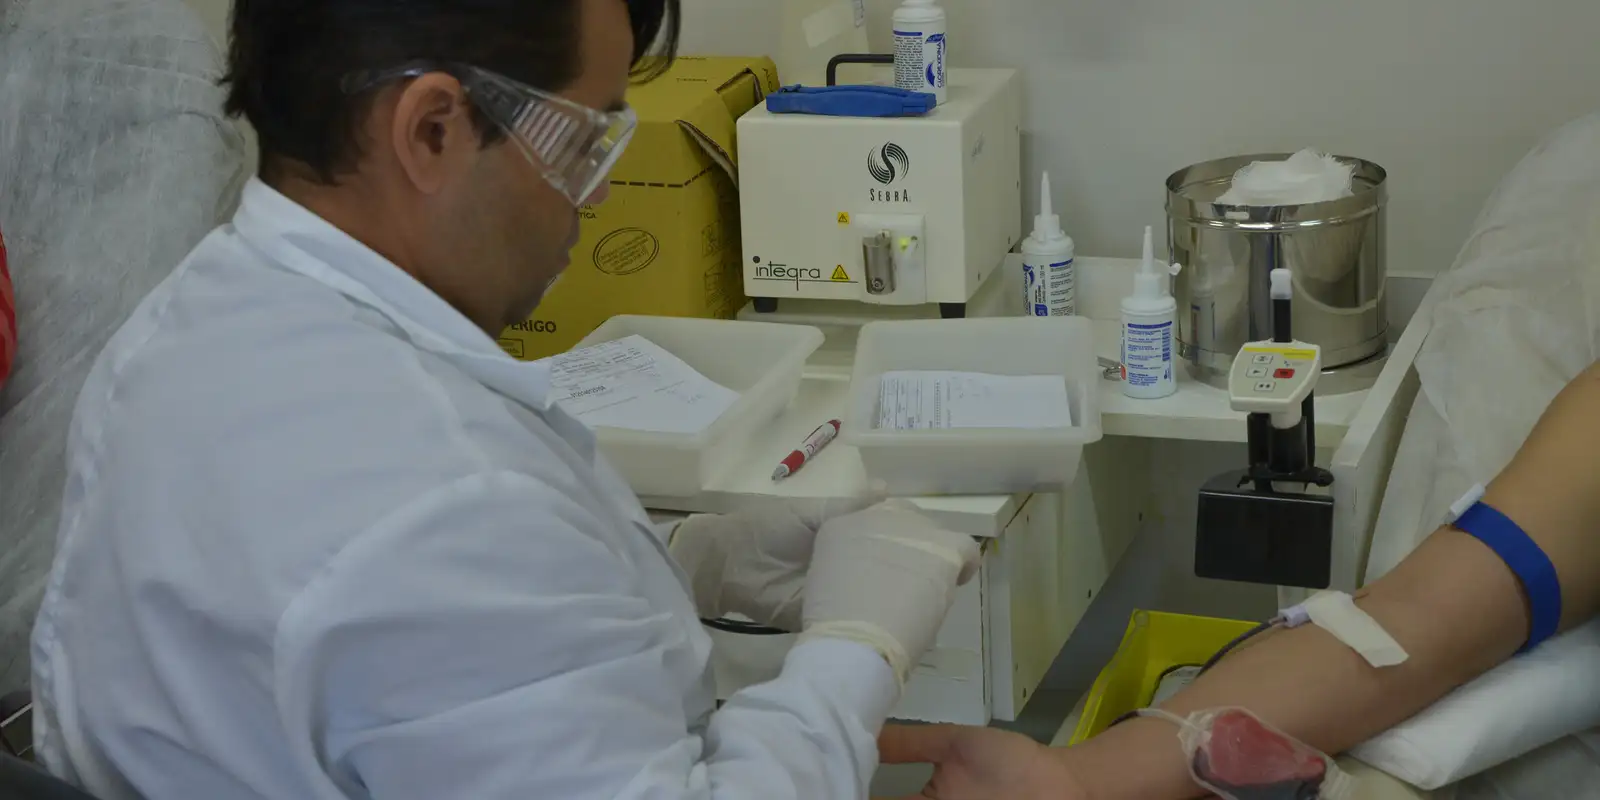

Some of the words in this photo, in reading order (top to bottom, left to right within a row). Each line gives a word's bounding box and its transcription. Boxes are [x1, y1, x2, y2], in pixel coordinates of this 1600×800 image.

[870, 188, 909, 202] SEBRA
[753, 256, 821, 291] integra
[507, 319, 557, 334] ERIGO
